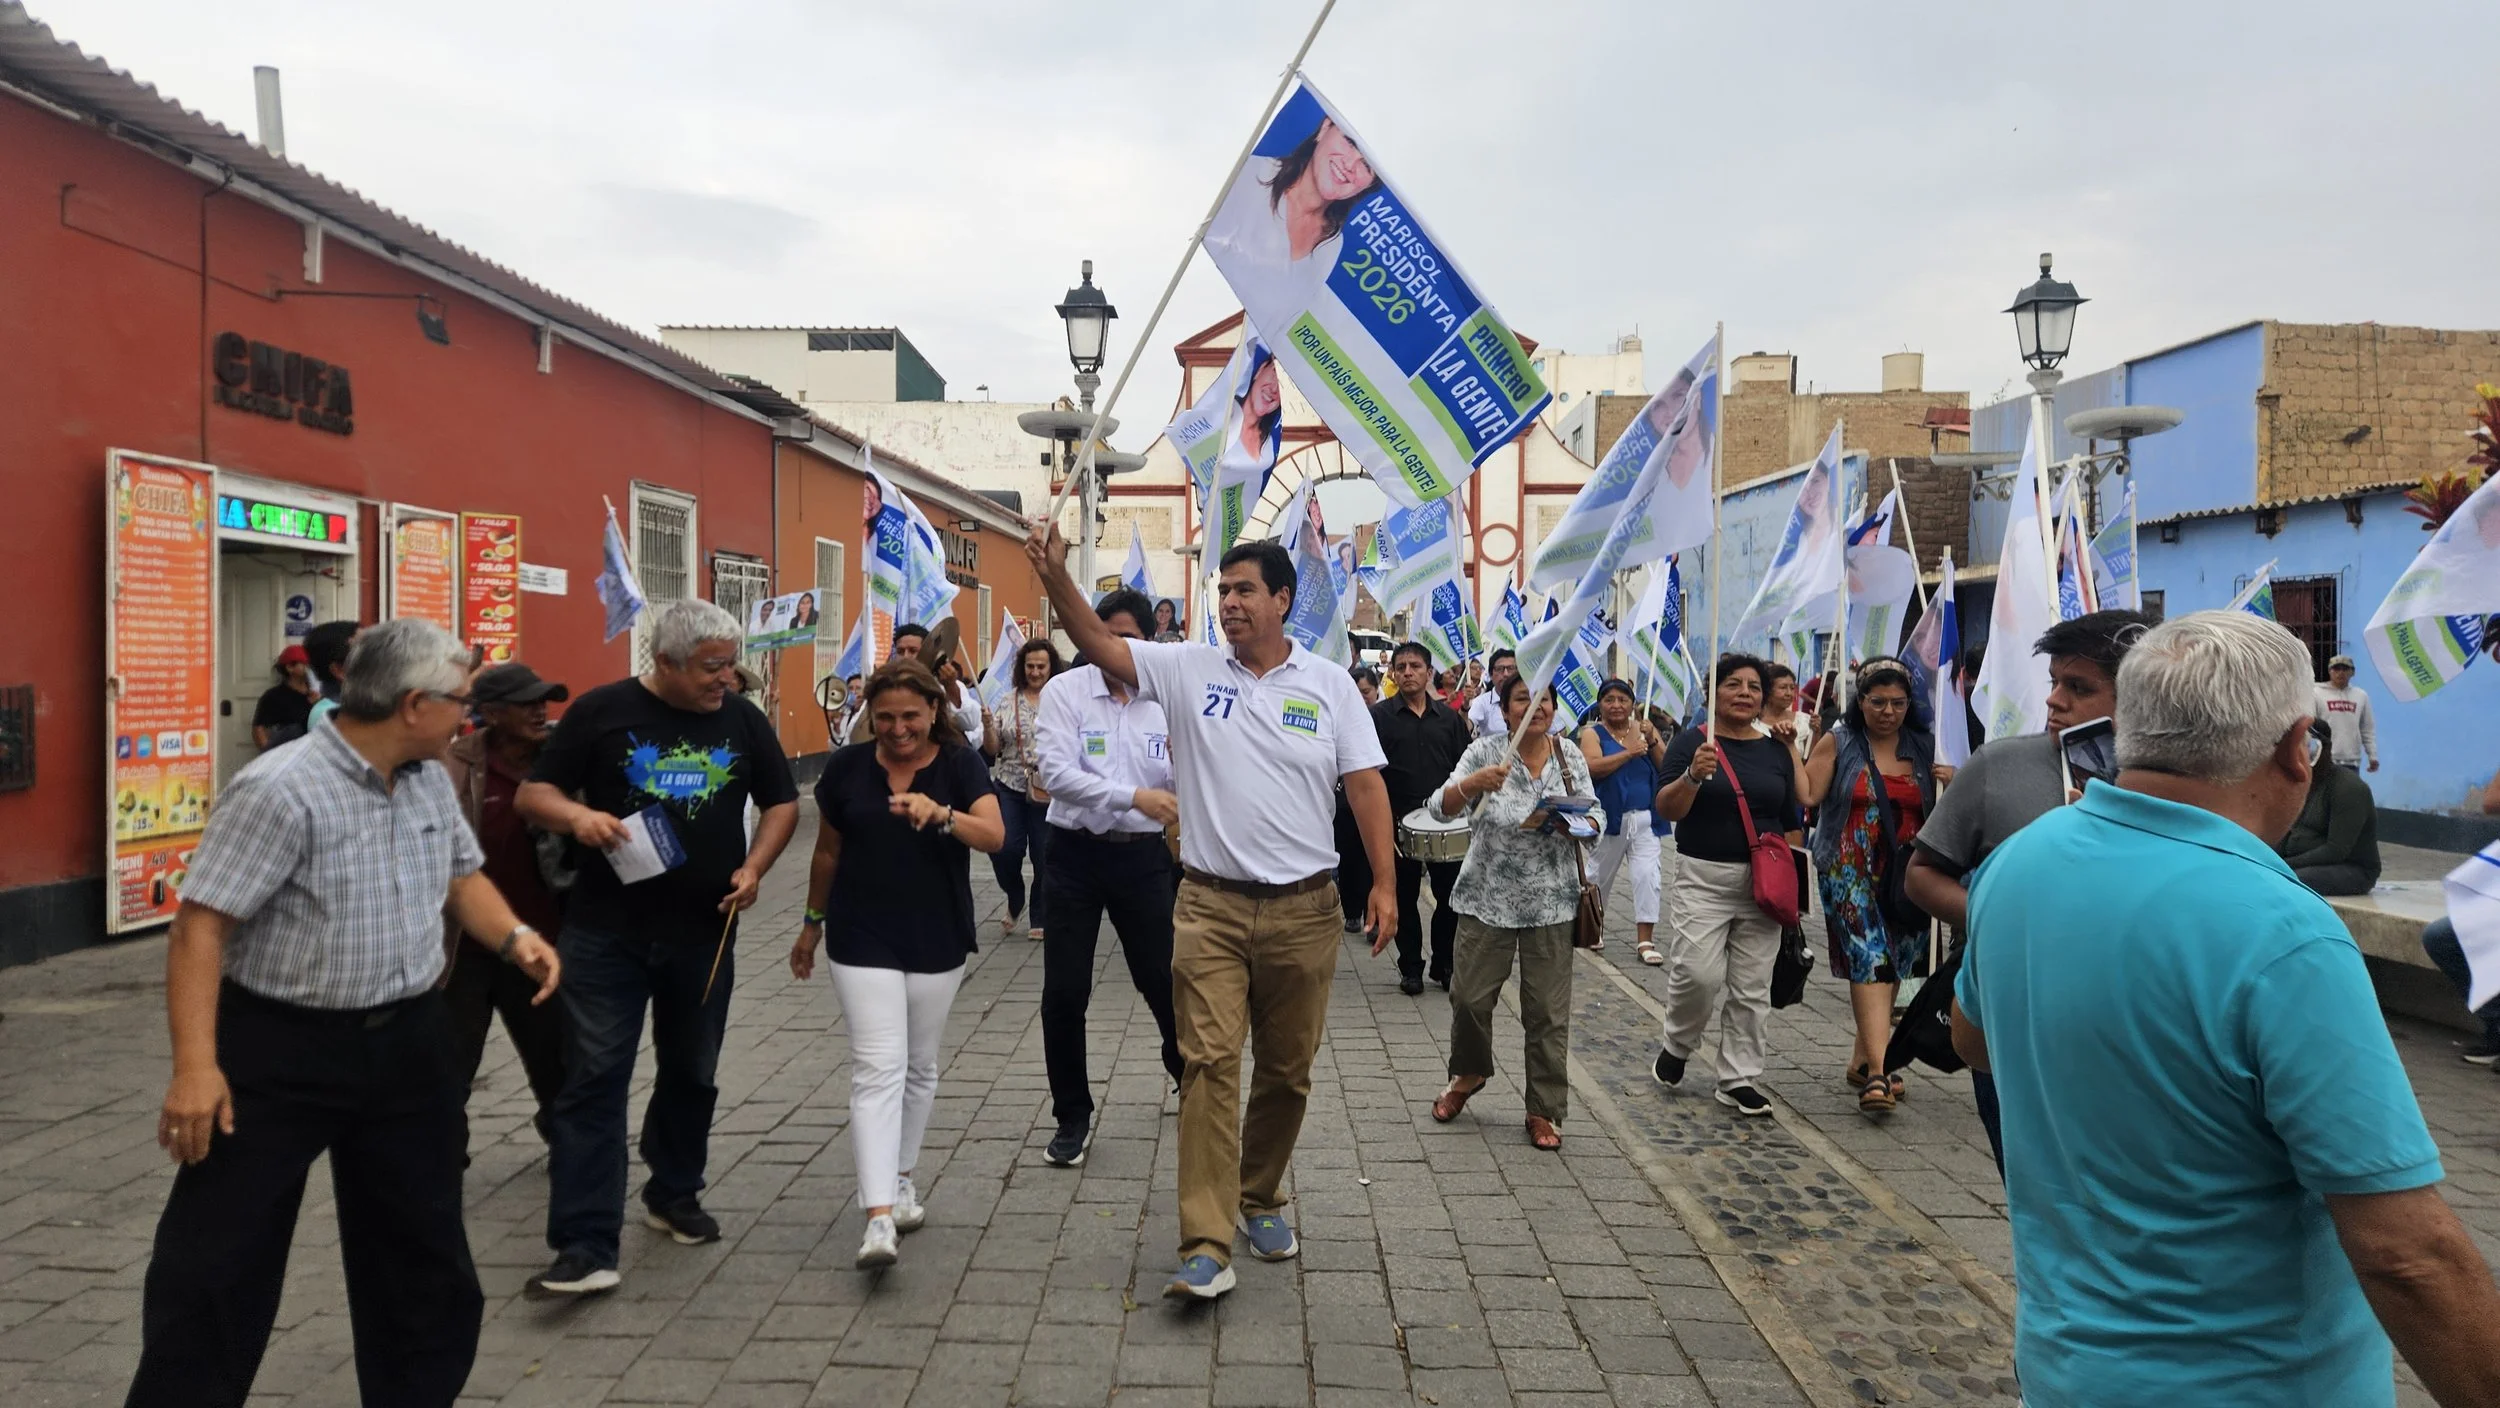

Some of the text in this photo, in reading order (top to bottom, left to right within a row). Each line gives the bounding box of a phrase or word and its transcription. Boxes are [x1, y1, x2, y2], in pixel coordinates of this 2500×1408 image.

[1367, 195, 1442, 284] MARISOL
[1341, 248, 1417, 325] 2026
[1349, 209, 1457, 333] PRESIDENTA
[213, 332, 352, 416] CHIFA
[1468, 324, 1532, 402] PRIMERO
[1294, 325, 1438, 493] ¡POR UN PAÍS MEJOR, PARA LA GENTE!
[1429, 348, 1510, 440] LA GENTE
[134, 482, 189, 516] CHIFA
[1433, 588, 1457, 620] SIDENTA
[1560, 681, 1572, 696] LA
[1566, 690, 1586, 715] GENTE
[1571, 673, 1594, 701] PRIMERO
[1203, 693, 1234, 719] 21
[1287, 705, 1315, 717] PRIMERO
[1283, 715, 1317, 731] LA GENTE
[161, 738, 180, 750] VISA
[1155, 742, 1160, 757] 1
[660, 773, 704, 786] LA GENTE
[116, 852, 143, 870] MENÚ
